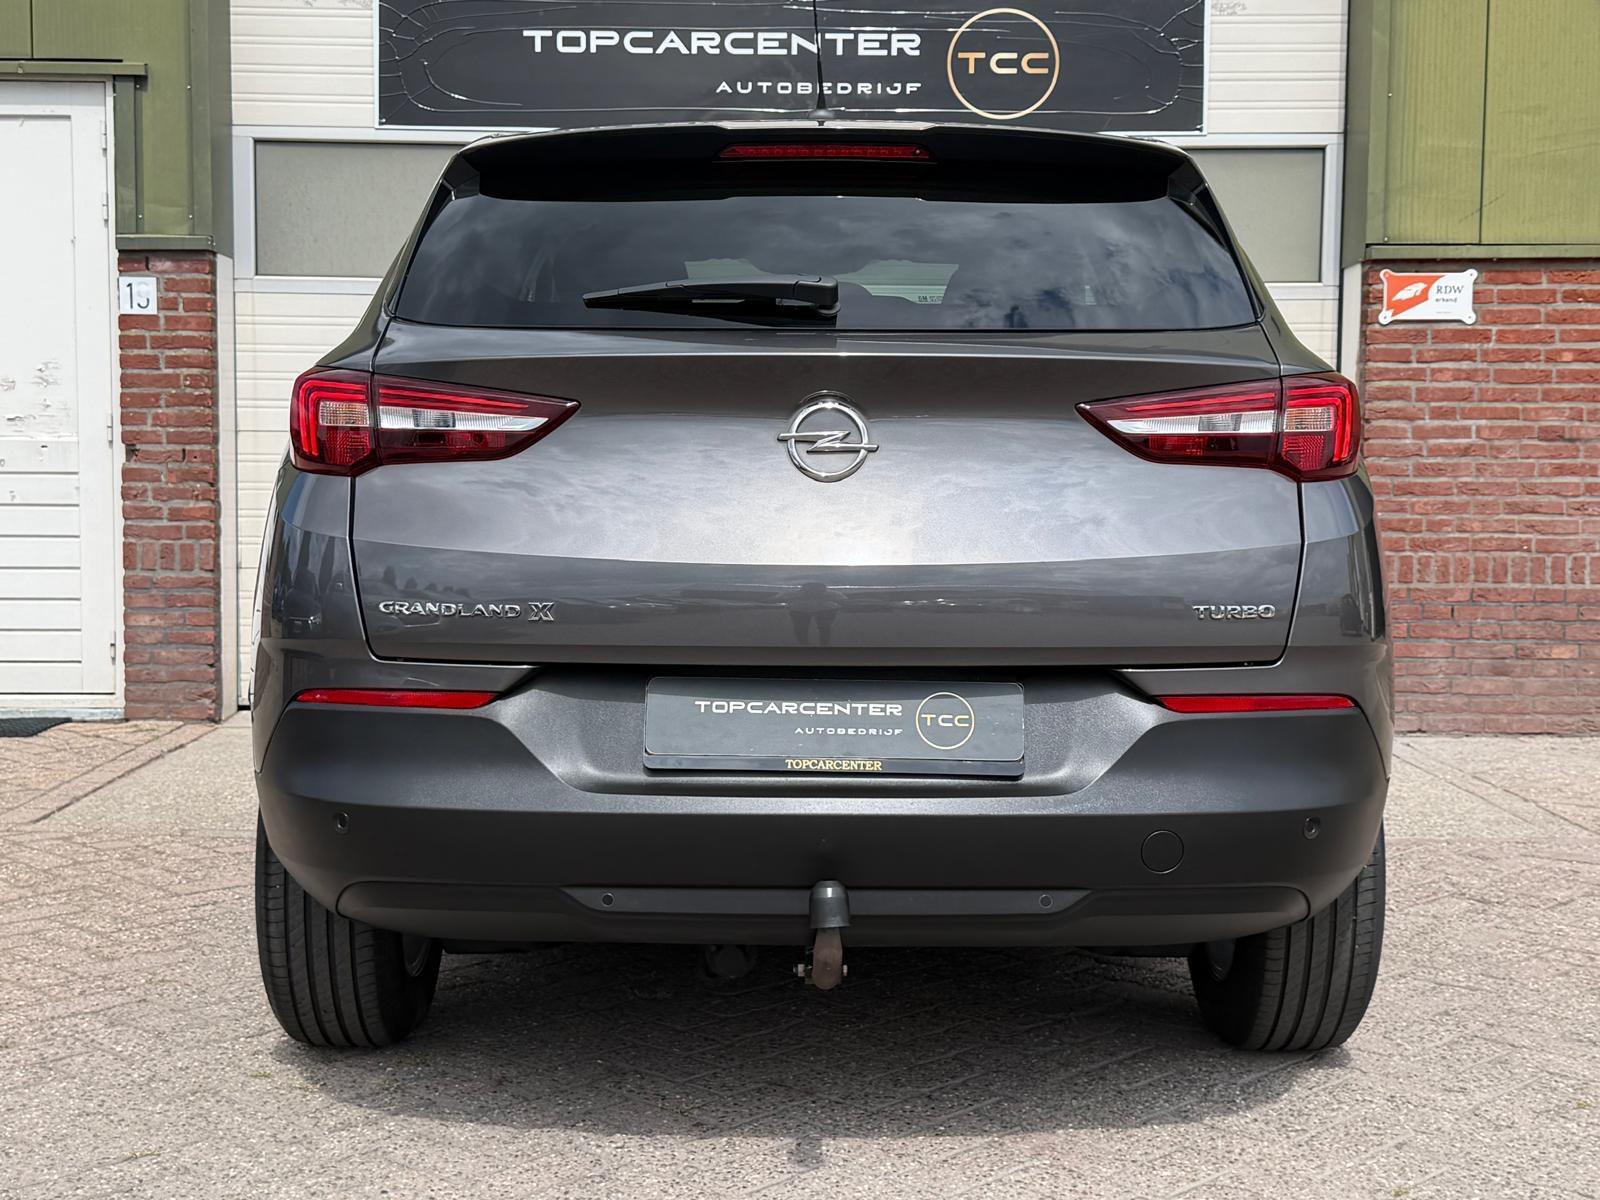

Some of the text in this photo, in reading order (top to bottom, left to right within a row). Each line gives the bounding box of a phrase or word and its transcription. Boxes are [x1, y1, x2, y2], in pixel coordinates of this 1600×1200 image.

[522, 30, 921, 56] TOPCARCENTER
[957, 51, 1050, 74] TCC
[715, 81, 922, 95] AUTOBEDRIJF
[1436, 285, 1464, 294] RDW
[379, 601, 555, 621] GRANDLAND X
[1192, 604, 1276, 619] TURBO
[695, 700, 903, 716] TOPCARCENTER
[921, 714, 970, 727] TCC
[794, 727, 903, 736] AUTOBEDRIJF
[785, 759, 882, 771] TOPCARCENTER
